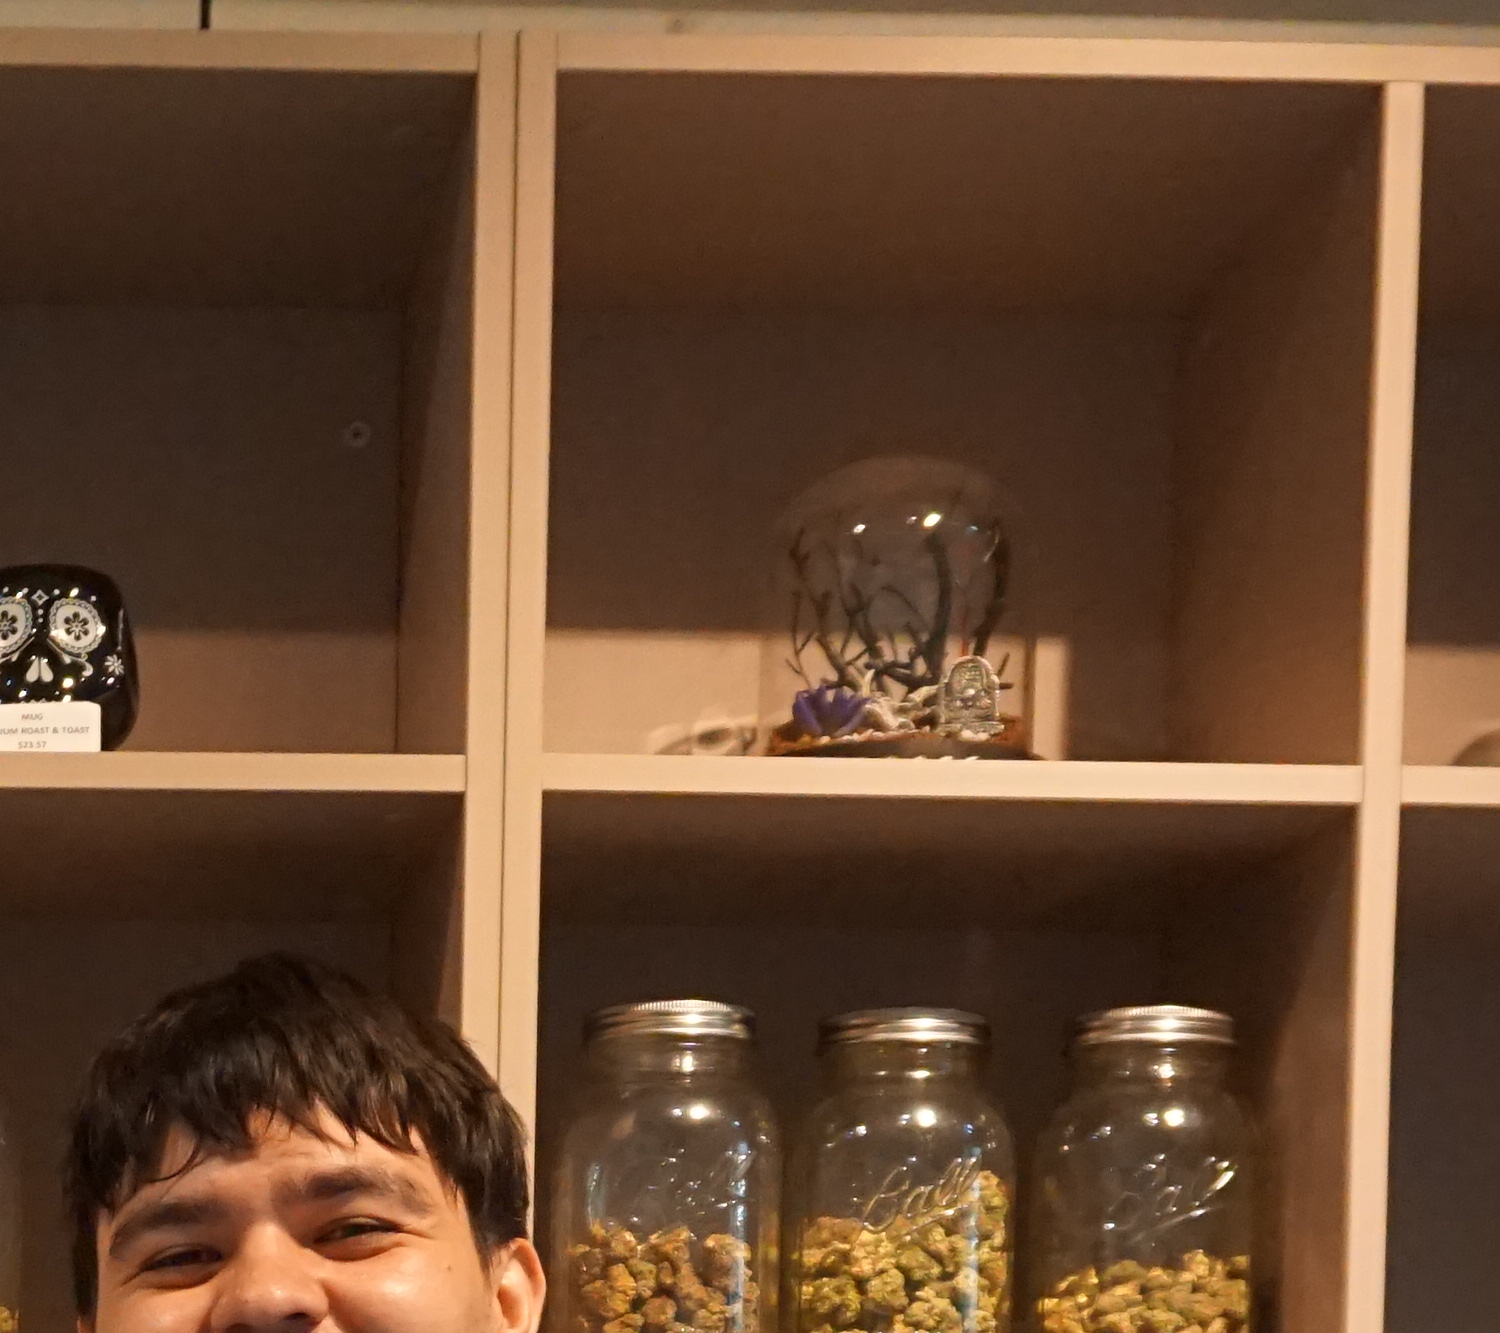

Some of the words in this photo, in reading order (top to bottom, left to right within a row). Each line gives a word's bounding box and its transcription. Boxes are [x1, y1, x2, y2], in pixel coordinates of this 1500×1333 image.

[21, 712, 44, 722] MUG
[21, 726, 49, 735] ROAST
[52, 726, 59, 735] &
[61, 725, 91, 735] TOAST
[18, 740, 47, 750] $2357
